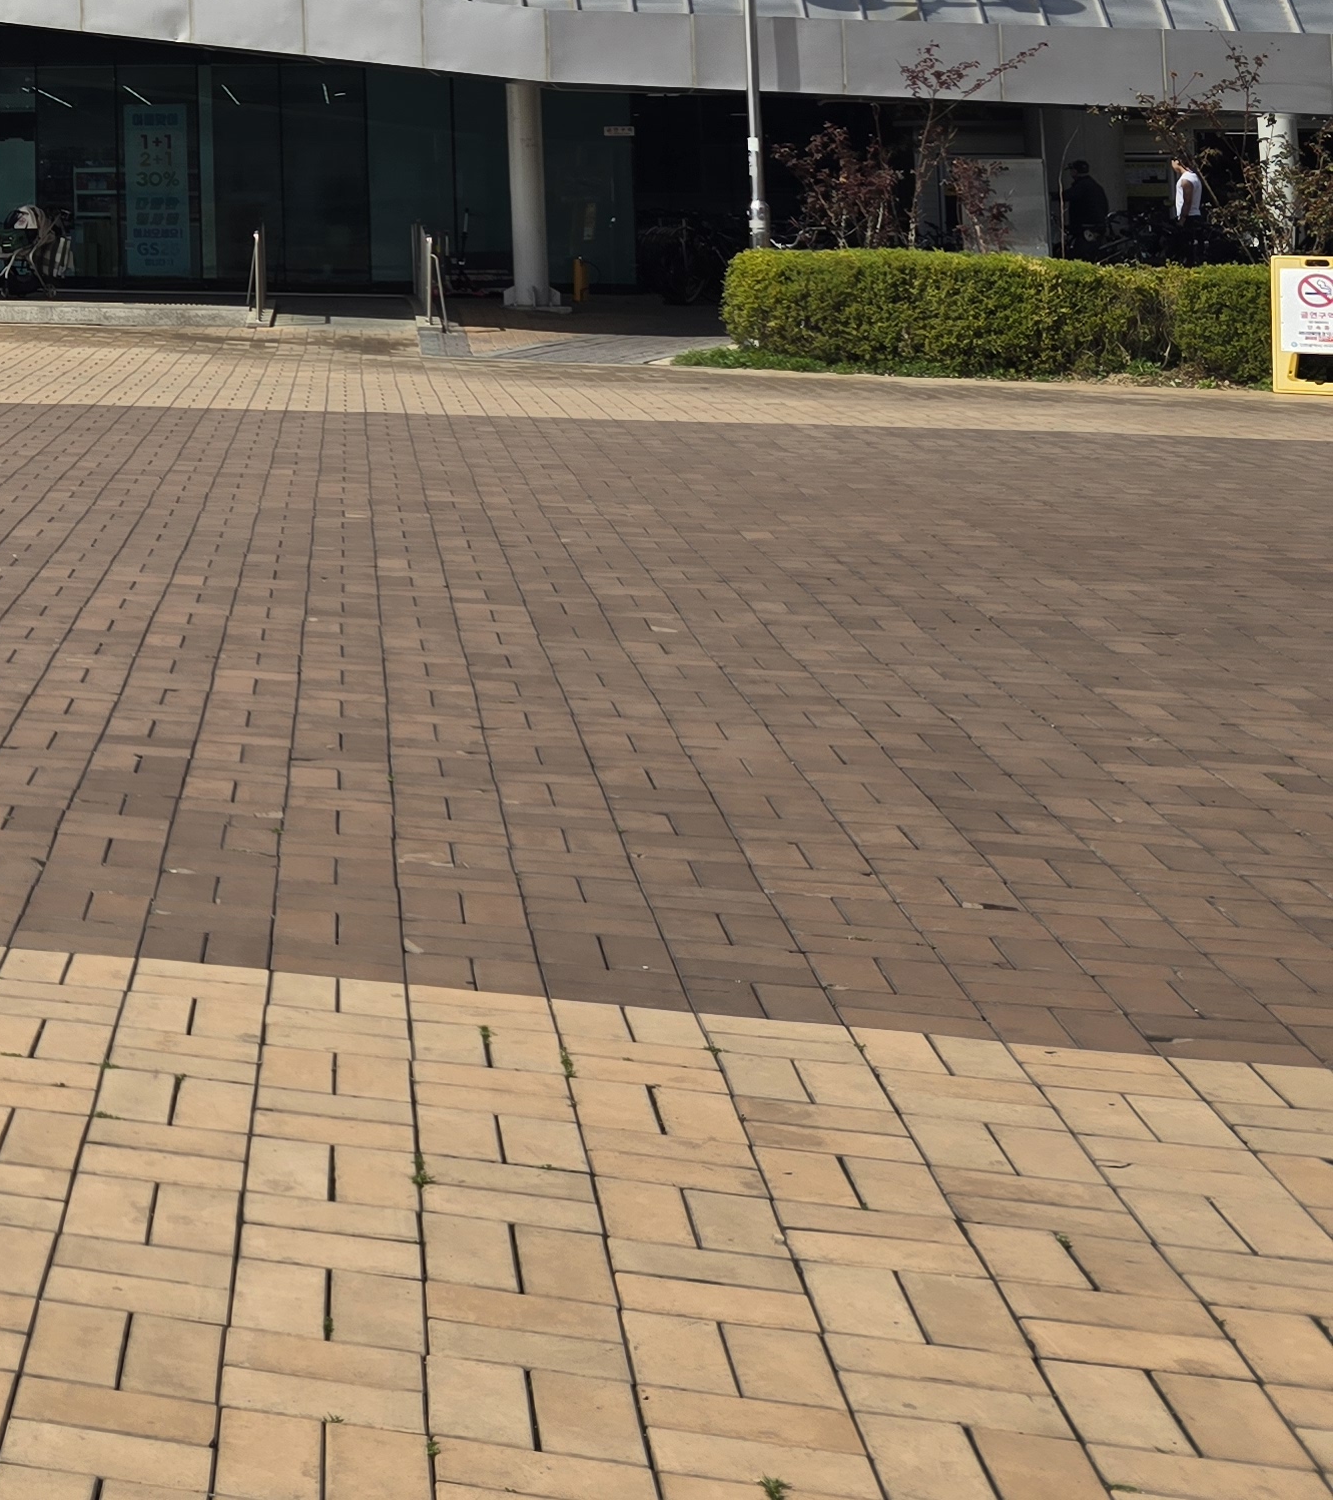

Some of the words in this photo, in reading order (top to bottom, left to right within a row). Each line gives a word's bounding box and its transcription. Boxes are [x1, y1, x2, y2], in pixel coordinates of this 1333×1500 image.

[140, 134, 172, 149] 1+1
[139, 151, 172, 167] 2+1
[136, 171, 180, 187] 30%
